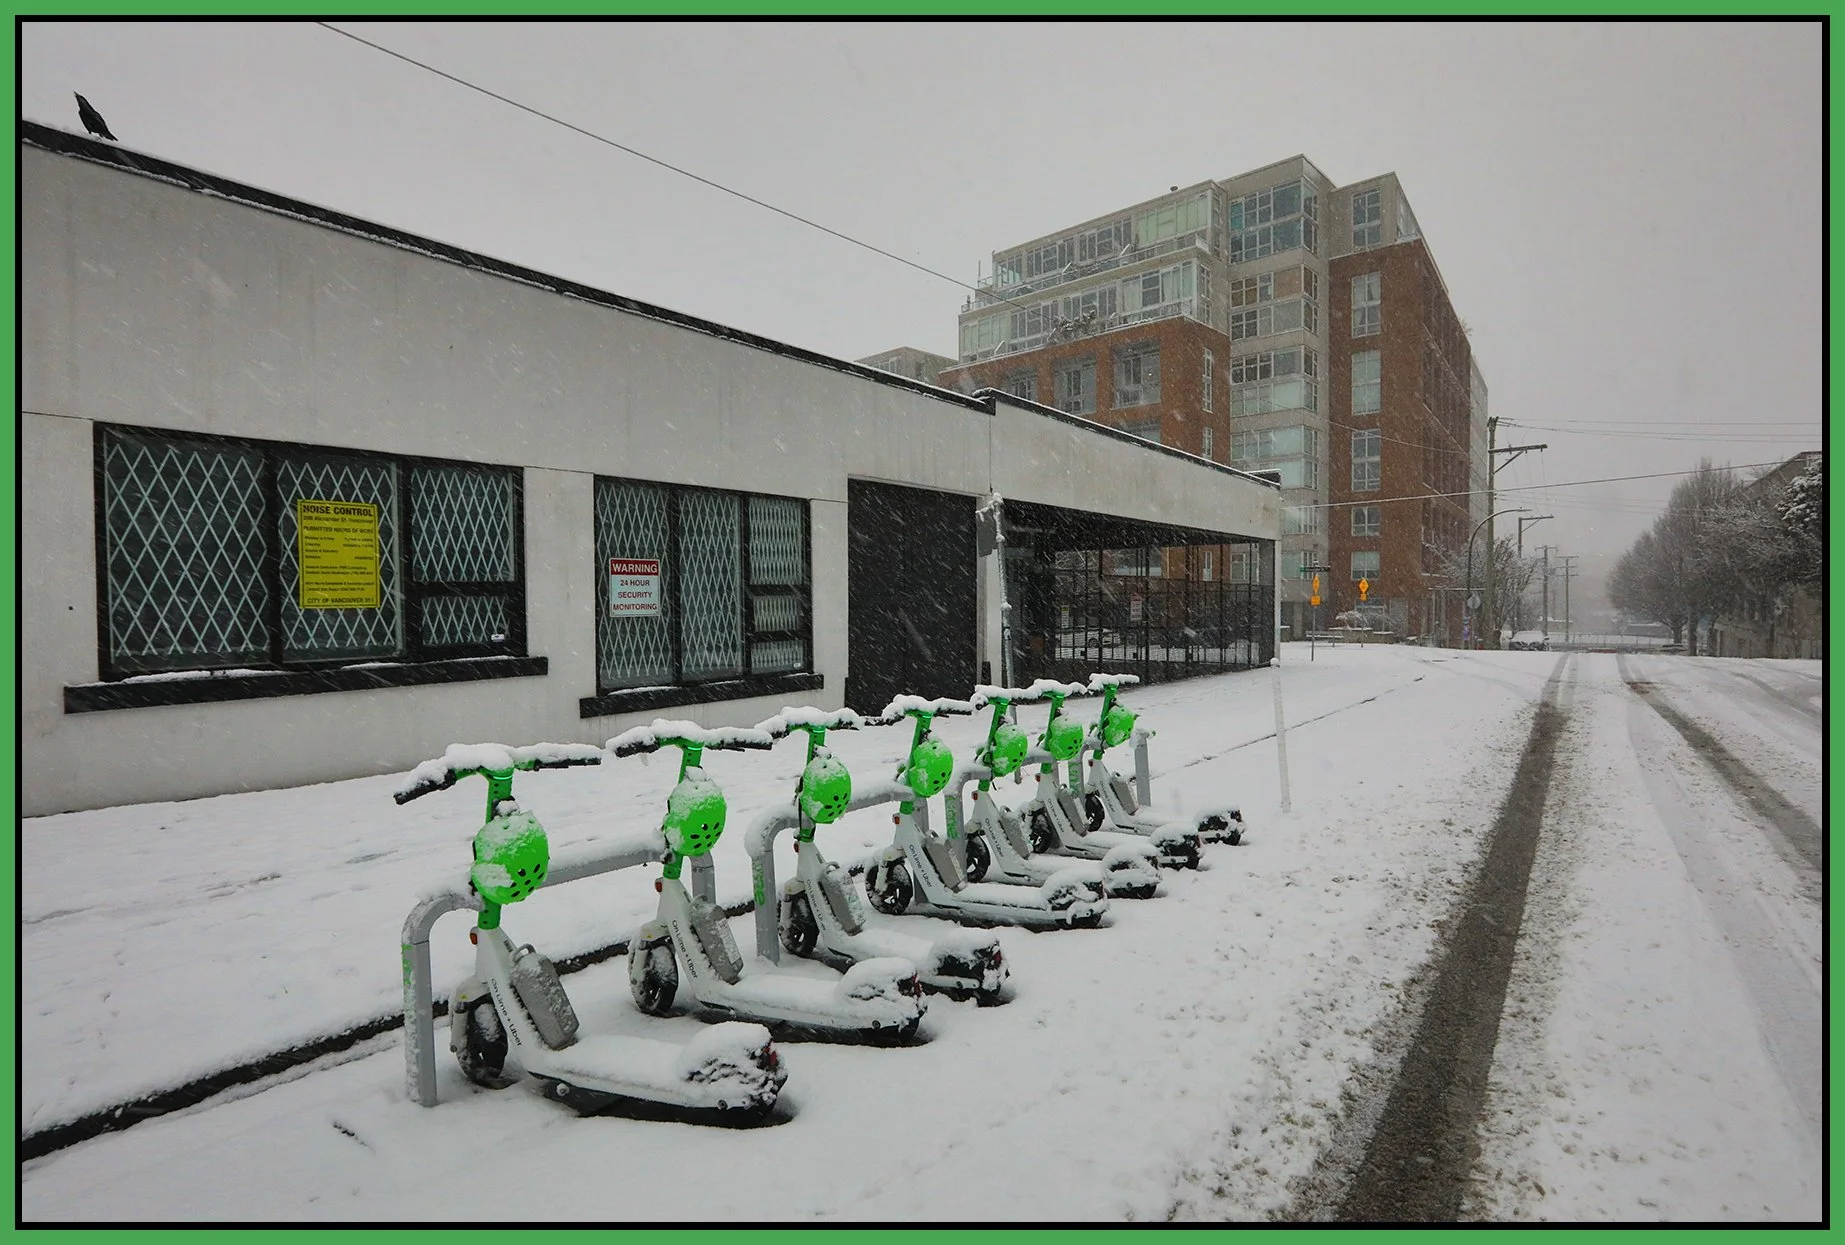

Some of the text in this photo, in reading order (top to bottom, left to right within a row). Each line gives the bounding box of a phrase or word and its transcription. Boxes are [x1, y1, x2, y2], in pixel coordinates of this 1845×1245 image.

[303, 505, 373, 517] NOISE CONTROL
[612, 563, 658, 573] WARNING
[620, 579, 650, 587] 24 HOUR
[617, 591, 653, 599] SECURITY
[612, 603, 658, 611] MONITORING
[671, 919, 679, 933] On
[687, 958, 698, 979] Uber
[491, 977, 499, 993] On
[496, 993, 508, 1016] Lime
[509, 1023, 522, 1047] Uber
